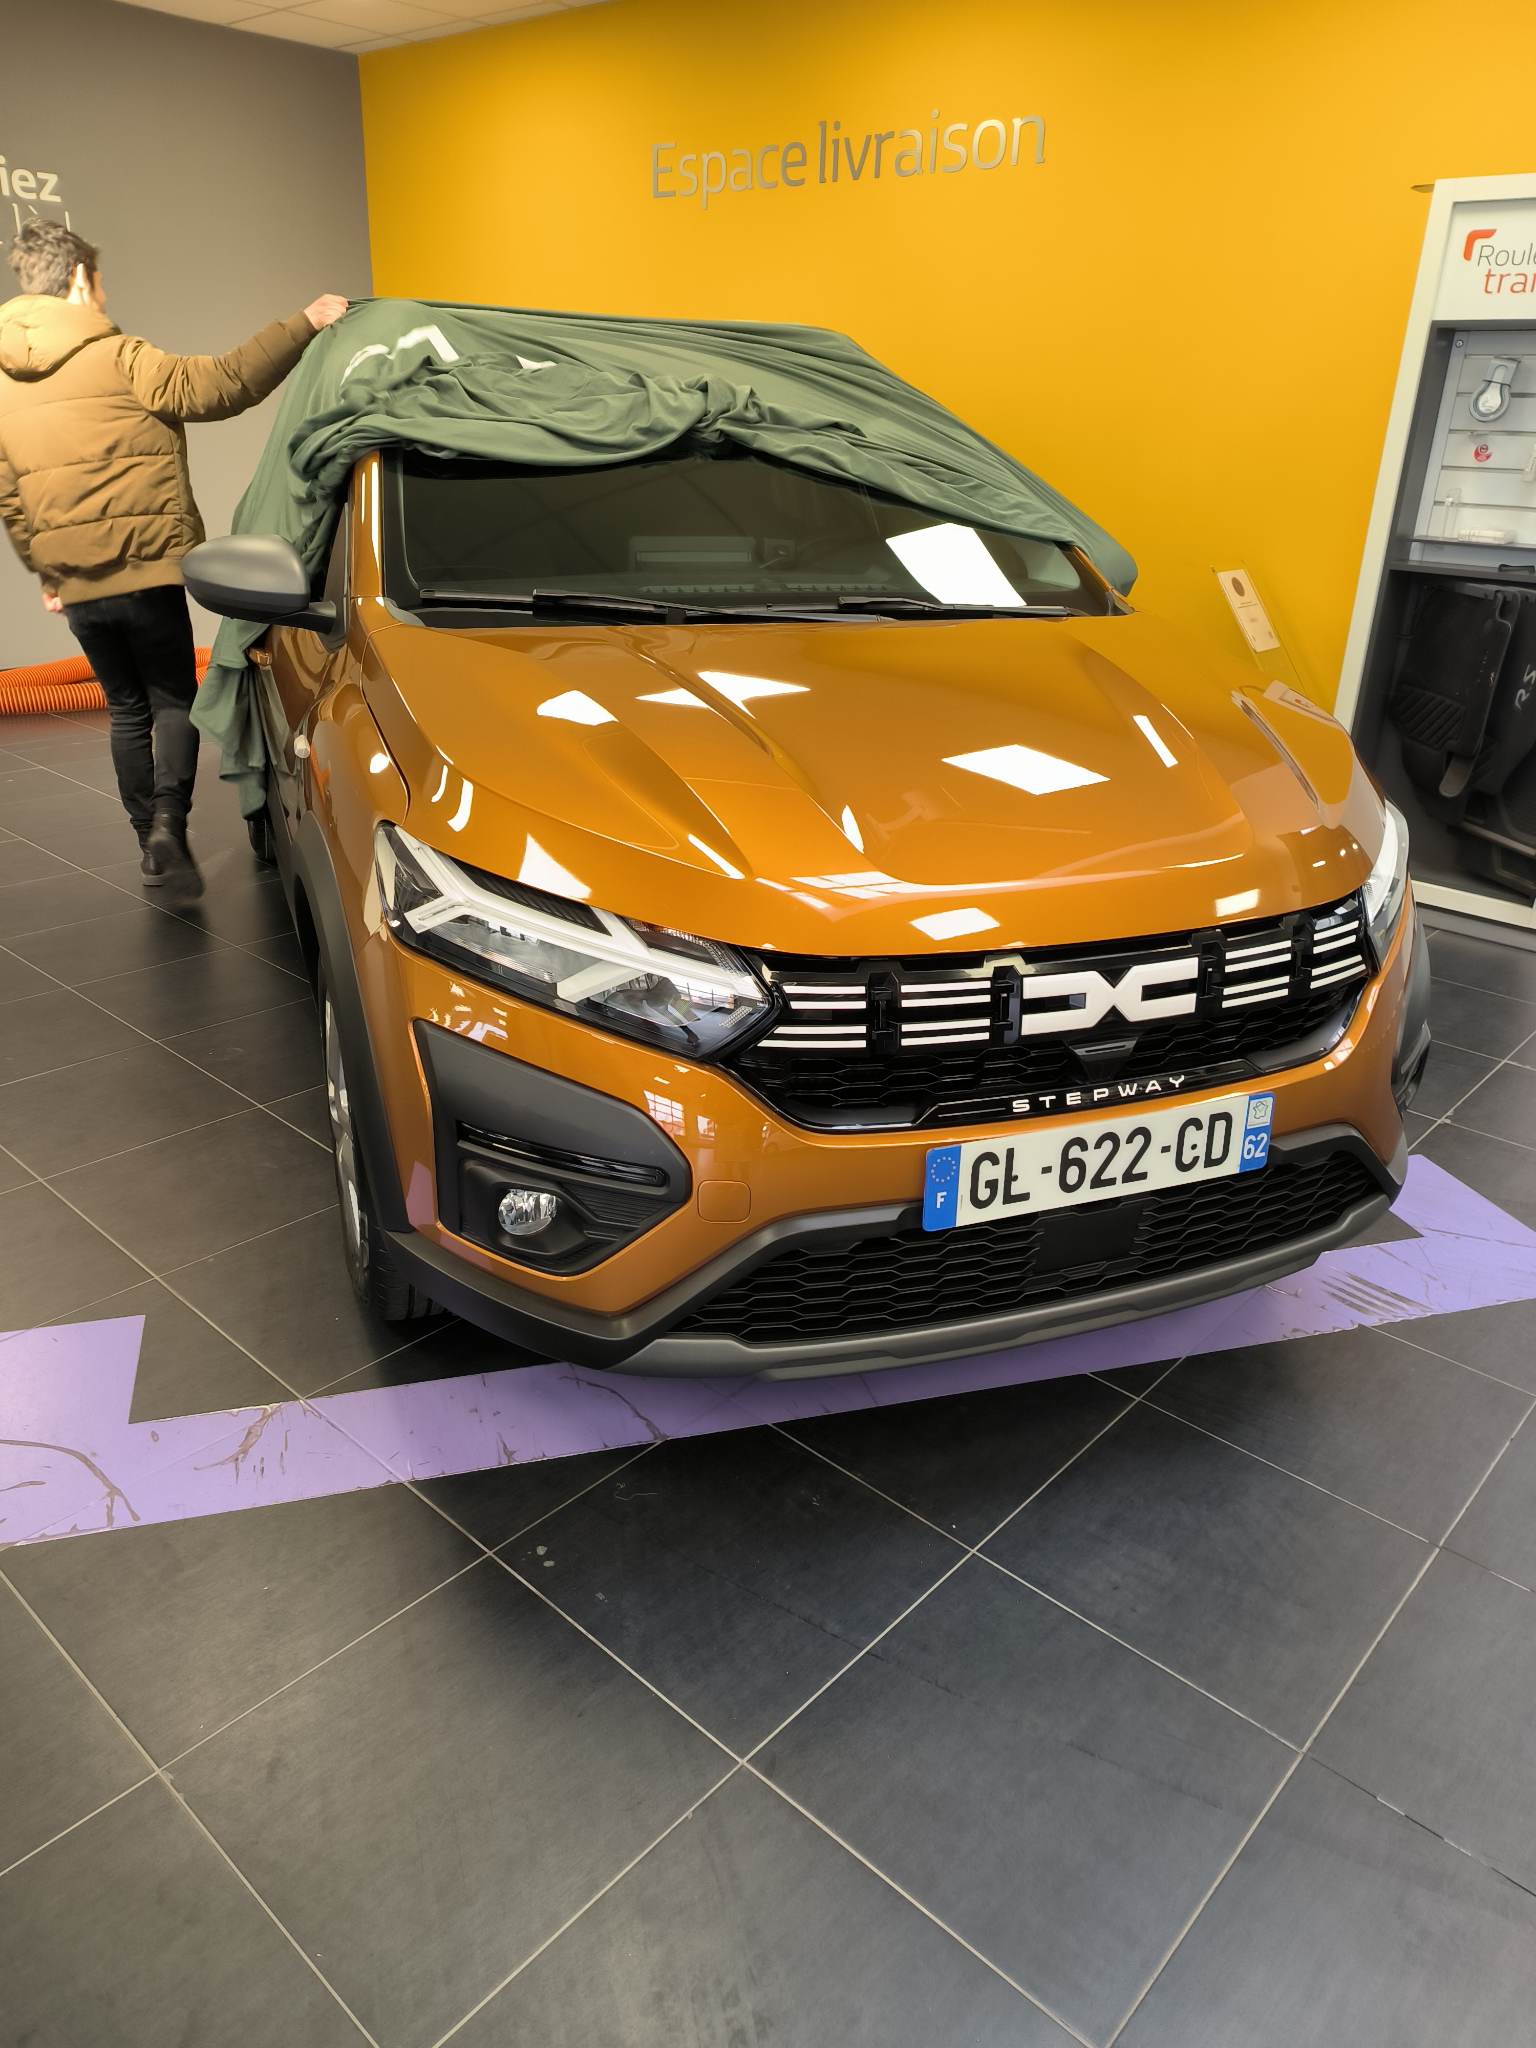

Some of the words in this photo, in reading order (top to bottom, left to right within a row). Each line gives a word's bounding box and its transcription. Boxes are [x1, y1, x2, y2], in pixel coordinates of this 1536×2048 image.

[652, 140, 808, 210] Espace
[817, 109, 1046, 184] livraison
[1477, 242, 1536, 267] Roul
[1012, 1074, 1185, 1113] STEPWAY
[936, 1191, 947, 1209] F
[1243, 1132, 1267, 1160] 62
